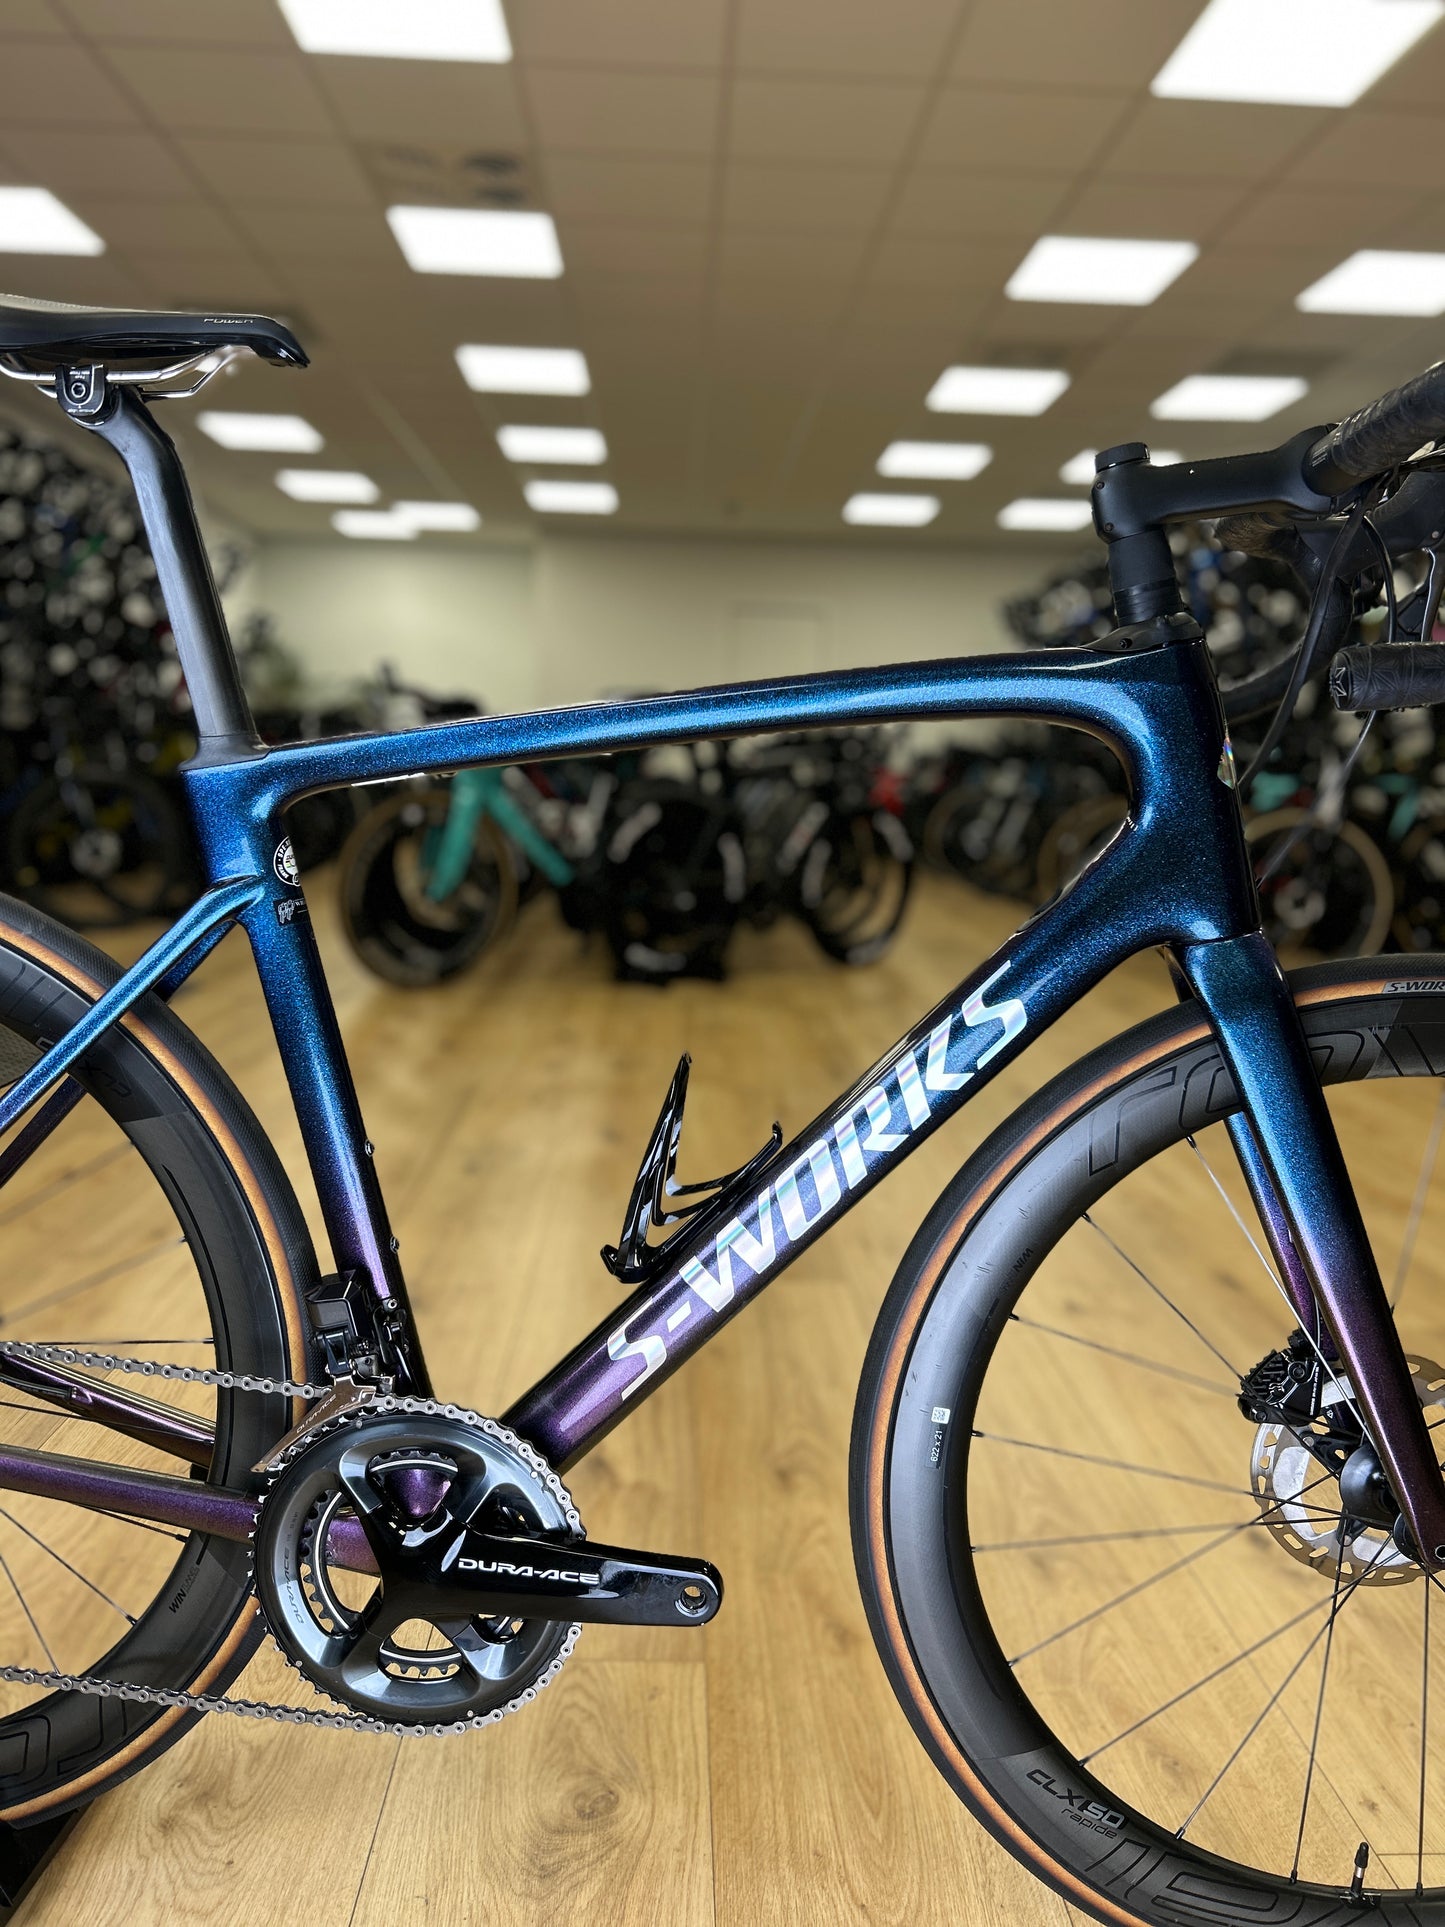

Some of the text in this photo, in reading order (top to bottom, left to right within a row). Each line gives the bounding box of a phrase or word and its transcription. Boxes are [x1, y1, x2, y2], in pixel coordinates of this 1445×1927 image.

[607, 960, 1028, 1400] S-WORKS
[934, 1430, 943, 1440] 21
[930, 1447, 940, 1462] 622
[458, 1557, 600, 1585] DURA-ACE
[1061, 1808, 1118, 1840] rapide
